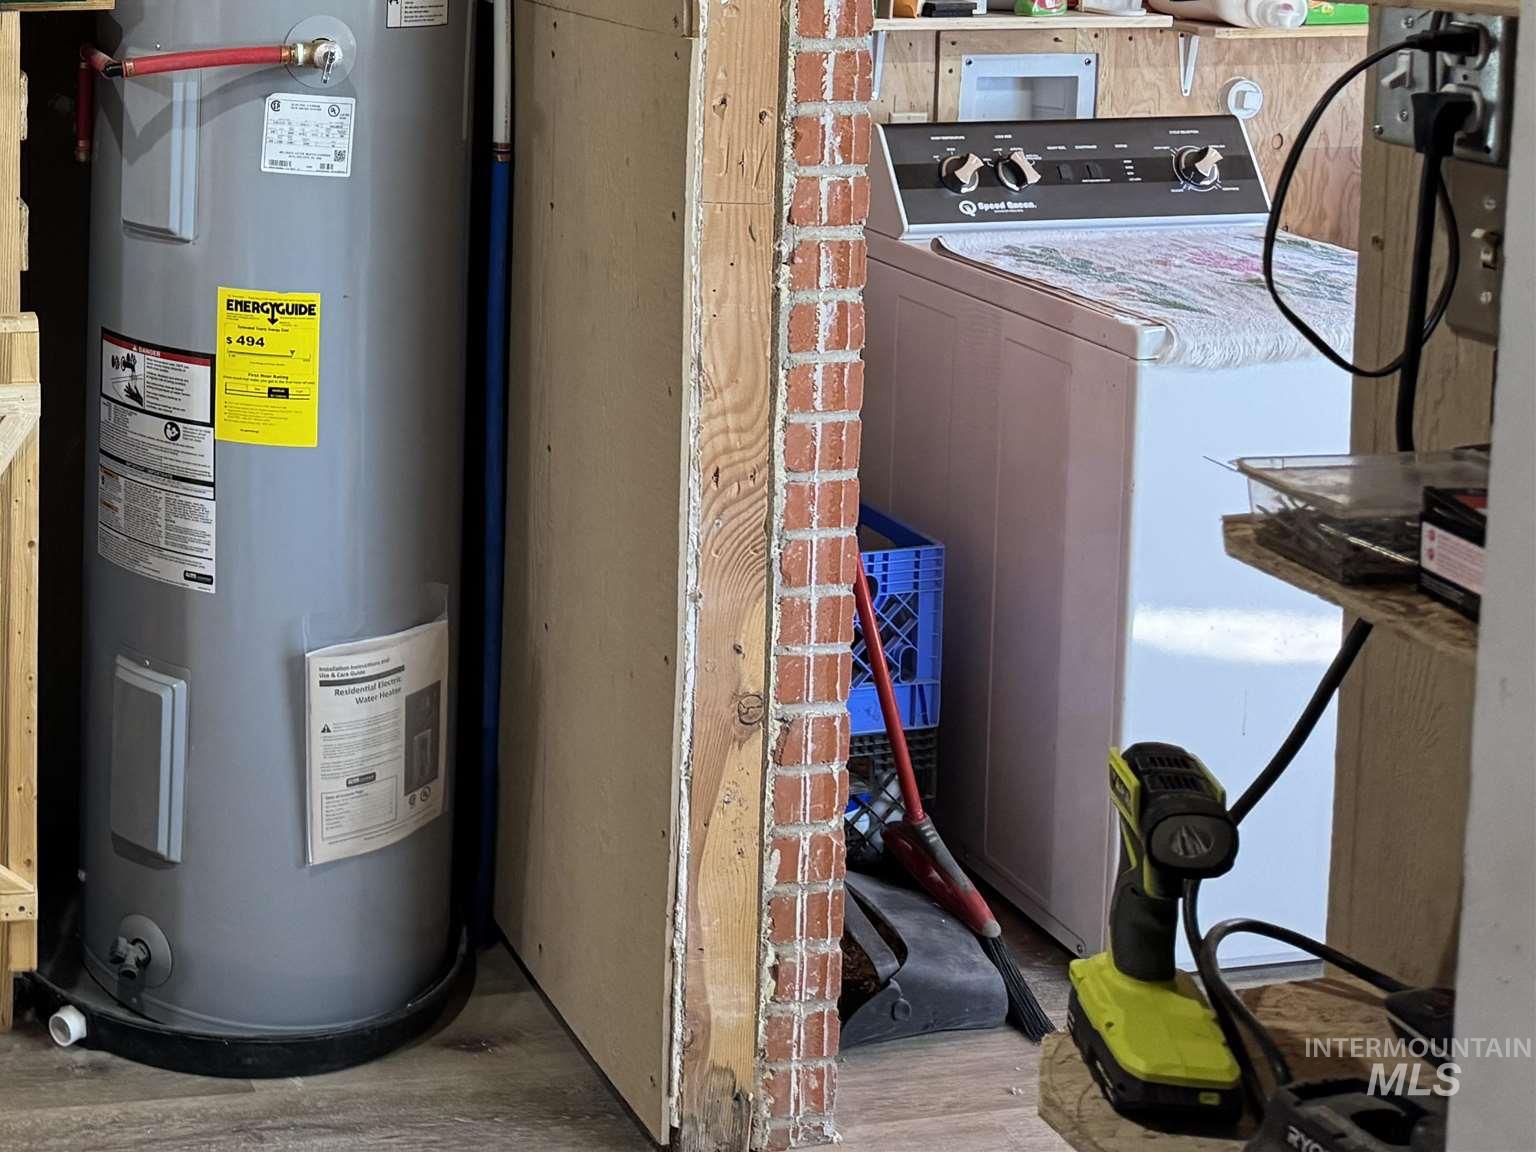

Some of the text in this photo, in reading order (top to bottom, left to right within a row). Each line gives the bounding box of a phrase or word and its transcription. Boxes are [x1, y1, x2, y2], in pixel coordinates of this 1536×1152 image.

[977, 201, 1006, 211] Speed
[226, 335, 265, 348] $ 494
[334, 682, 377, 696] Residential
[355, 694, 378, 705] Water
